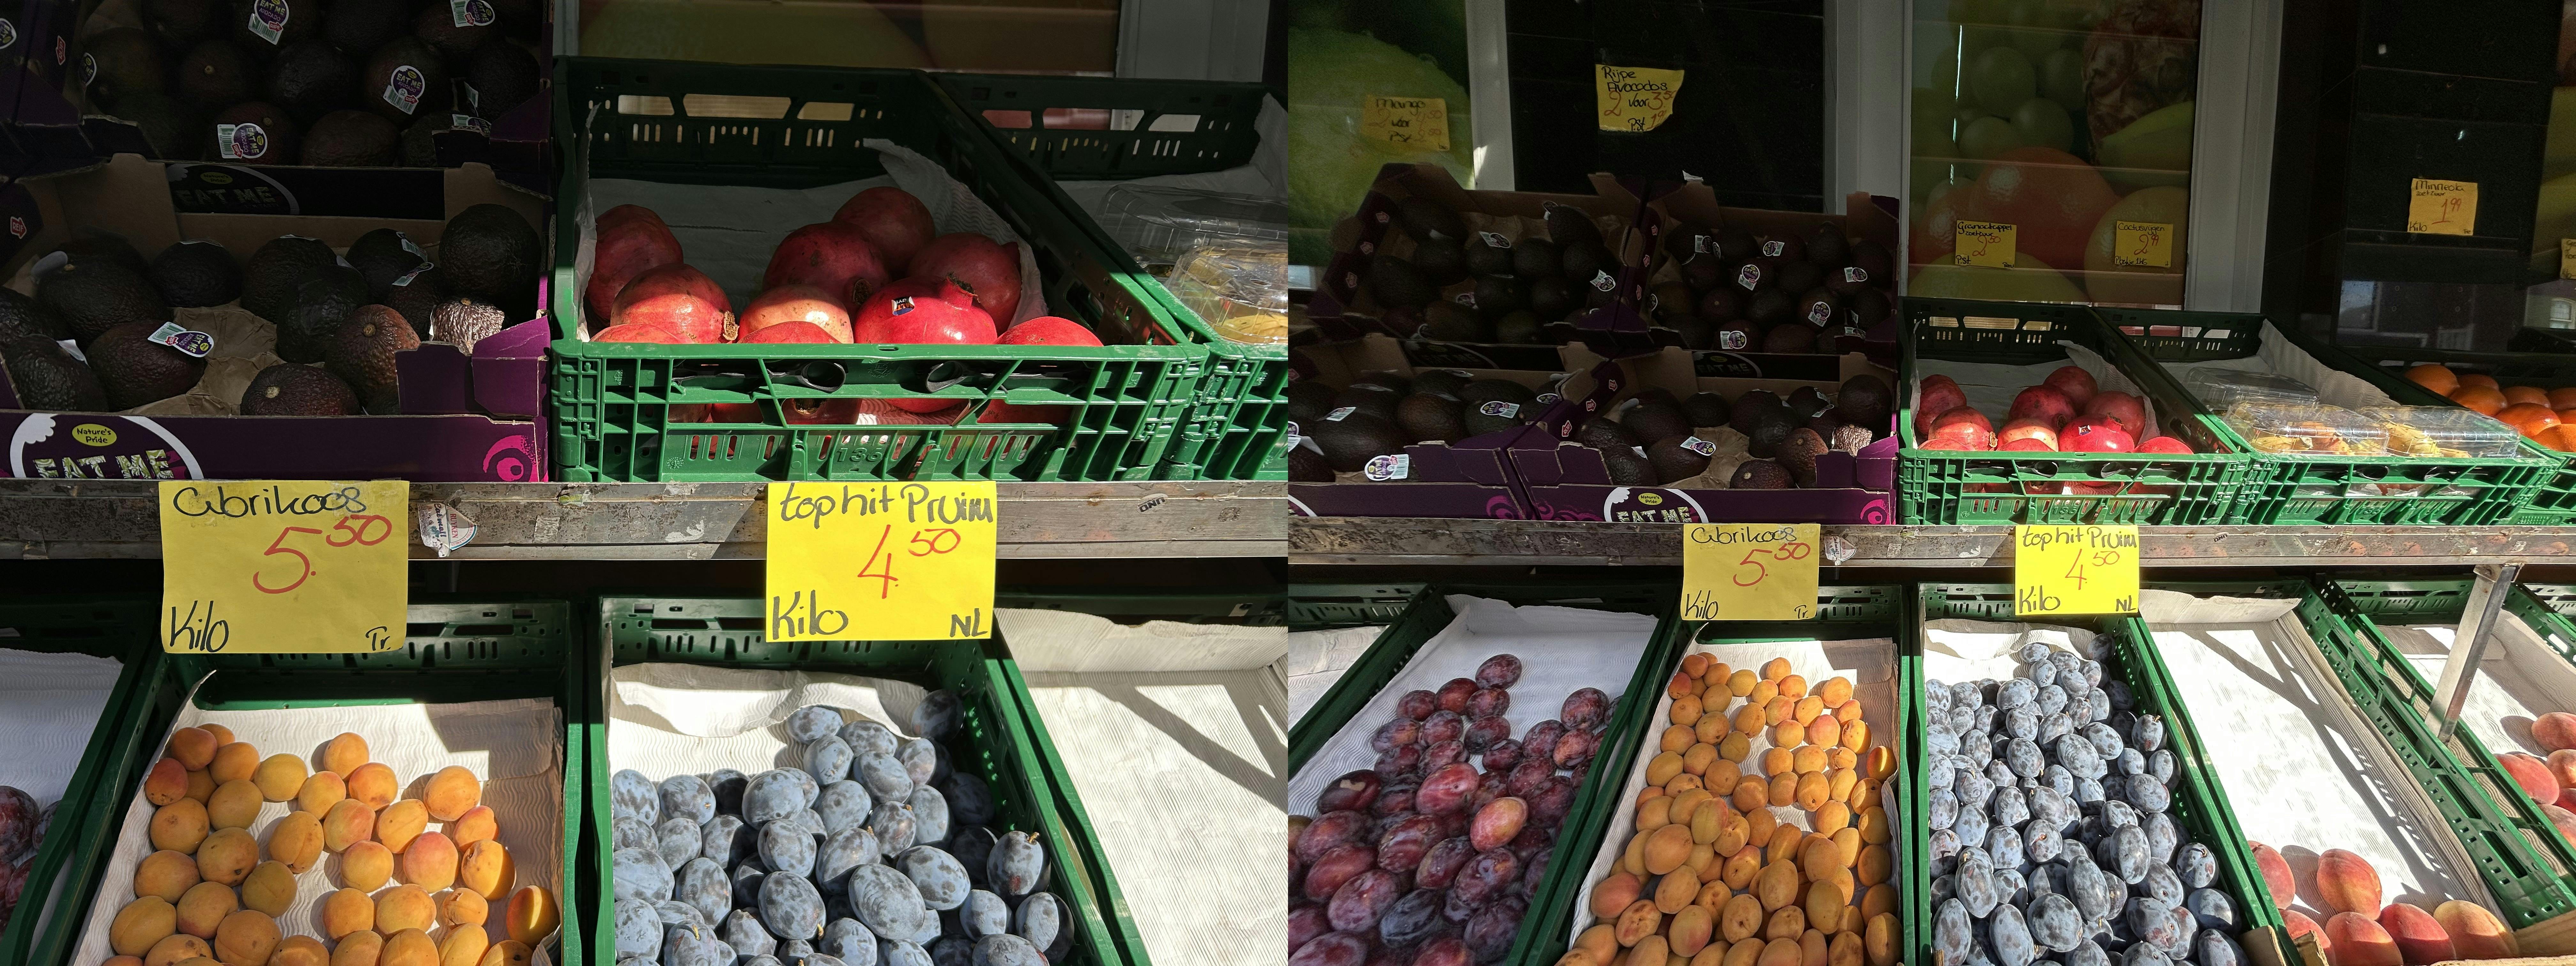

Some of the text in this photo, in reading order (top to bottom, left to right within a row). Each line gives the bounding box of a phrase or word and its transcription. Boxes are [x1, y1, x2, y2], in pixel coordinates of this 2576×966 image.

[259, 7, 280, 21] AVOCADO
[274, 6, 286, 16] ME
[396, 73, 411, 84] EAT
[411, 80, 422, 89] ME
[1601, 66, 1637, 83] Rijpe
[398, 81, 416, 93] AVOCADO
[1604, 90, 1621, 116] 2
[240, 129, 249, 153] AVOCADO
[246, 127, 260, 153] EAT ME
[233, 145, 241, 156] RIPE
[2415, 180, 2465, 192] Minneola
[233, 186, 278, 204] ME
[12, 223, 23, 232] REIF
[2409, 221, 2427, 232] Kilo
[192, 334, 205, 344] EAT
[187, 342, 198, 353] ME
[77, 428, 111, 436] Nature's
[836, 447, 883, 462] 136
[33, 449, 174, 479] EAT ME
[1139, 497, 1165, 512] UNO
[1616, 506, 1693, 523] EAT ME
[450, 513, 458, 538] RUYKEN
[2213, 533, 2228, 542] UNO
[1685, 590, 1719, 620] Kilo
[2019, 585, 2137, 613] Kilo NL
[772, 589, 988, 640] Kilo NL
[169, 600, 229, 653] Kilo
